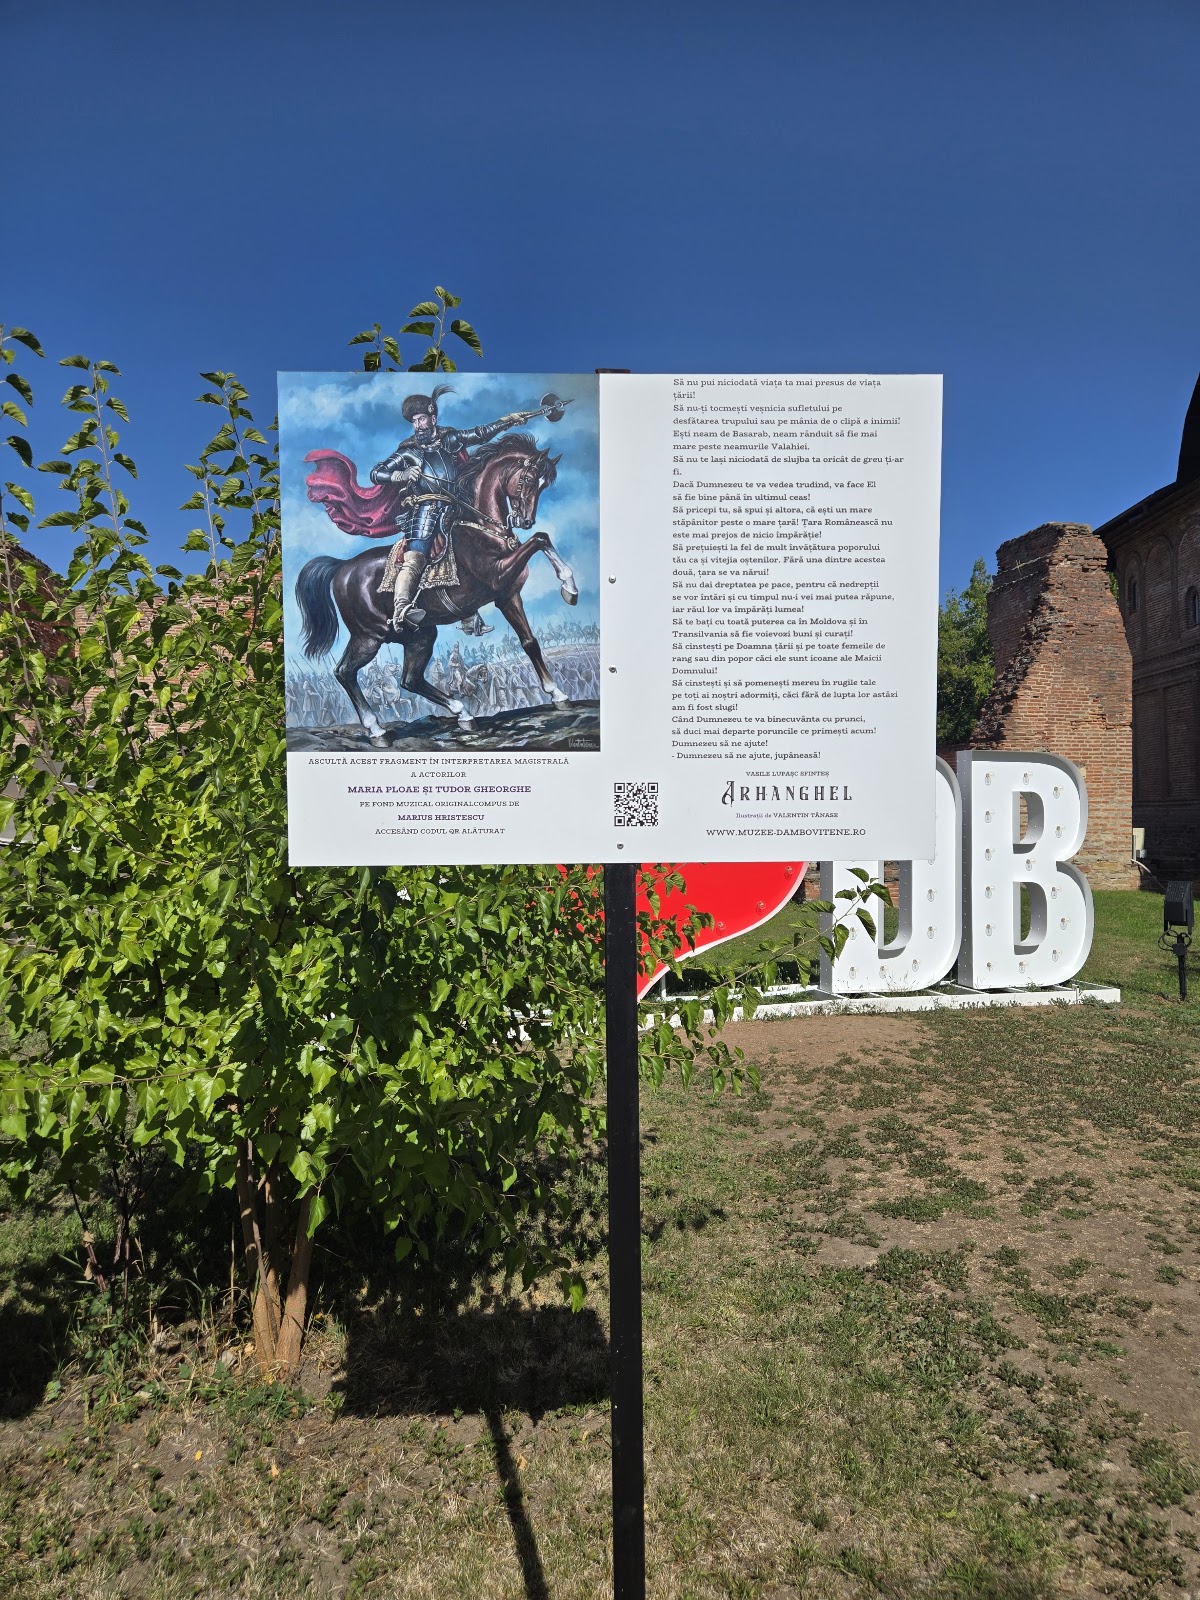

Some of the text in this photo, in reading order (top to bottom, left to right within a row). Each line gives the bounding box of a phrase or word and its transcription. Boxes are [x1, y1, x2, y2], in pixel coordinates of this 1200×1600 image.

[673, 378, 685, 386] Să
[700, 378, 716, 388] pui
[717, 378, 758, 387] niciodată
[760, 379, 783, 388] viața
[795, 378, 813, 386] mai
[814, 380, 845, 388] presus
[859, 379, 881, 389] viața
[673, 390, 695, 402] țării!
[673, 403, 842, 415] Să nu-ți tocmești veșnicia sufletului pe
[673, 430, 691, 440] Ești
[719, 430, 730, 438] de
[732, 430, 771, 439] Basarab,
[799, 429, 833, 438] rânduit
[847, 430, 859, 438] fie
[860, 430, 877, 438] mai
[698, 443, 722, 452] peste
[723, 442, 769, 450] neamurile
[771, 442, 810, 451] Valahiei.
[673, 468, 682, 476] fi.
[672, 480, 694, 489] Dacă
[696, 480, 743, 488] Dumnezeu
[768, 481, 794, 489] vedea
[795, 481, 832, 489] trudind,
[846, 480, 865, 489] face
[673, 493, 811, 503] să fie bine până în ultimul ceas!
[672, 518, 719, 528] stăpânitor
[720, 519, 744, 528] peste
[777, 518, 799, 529] țară!
[801, 518, 823, 528] Țara
[824, 518, 879, 526] Românească
[692, 531, 709, 539] mai
[711, 531, 738, 540] prejos
[740, 531, 751, 539] de
[752, 531, 774, 539] nicio
[776, 530, 822, 541] împărăție!
[672, 543, 881, 553] Să prețuiești la fel de mult învățătura poporului
[672, 568, 696, 577] două,
[697, 569, 717, 579] țara
[742, 568, 769, 576] nărui!
[672, 580, 683, 588] Să
[699, 581, 713, 589] dai
[714, 581, 757, 590] dreptatea
[758, 582, 769, 590] pe
[771, 582, 793, 590] pace,
[795, 582, 826, 590] pentru
[827, 580, 837, 588] că
[839, 580, 880, 590] nedrepții
[687, 605, 706, 613] răul
[707, 605, 720, 613] lor
[734, 605, 773, 615] împărăți
[774, 605, 804, 613] lumea!
[671, 629, 853, 640] Transilvania să fie voievozi buni și curați!
[671, 666, 718, 675] Domnului!
[671, 715, 695, 723] Când
[696, 715, 743, 723] Dumnezeu
[767, 715, 821, 723] binecuvânta
[834, 715, 866, 724] prunci,
[671, 727, 682, 735] să
[683, 727, 702, 735] duci
[703, 727, 721, 735] mai
[722, 727, 755, 737] departe
[756, 727, 798, 737] poruncile
[811, 727, 848, 737] primești
[719, 739, 729, 747] să
[744, 739, 768, 749] ajute!
[308, 756, 348, 765] ASCULTĂ
[429, 757, 439, 765] ÎN
[514, 757, 569, 765] MAGISTRALĂ
[347, 785, 531, 796] MARIA PLOAE ȘI TUDOR GHEORGHE
[722, 780, 853, 807] ARHANGHEL
[374, 827, 419, 835] ACCESÂND
[461, 826, 506, 835] ALĂTURAT
[705, 828, 866, 836] WWW.MUZEE-DAMBOVITENE.RO
